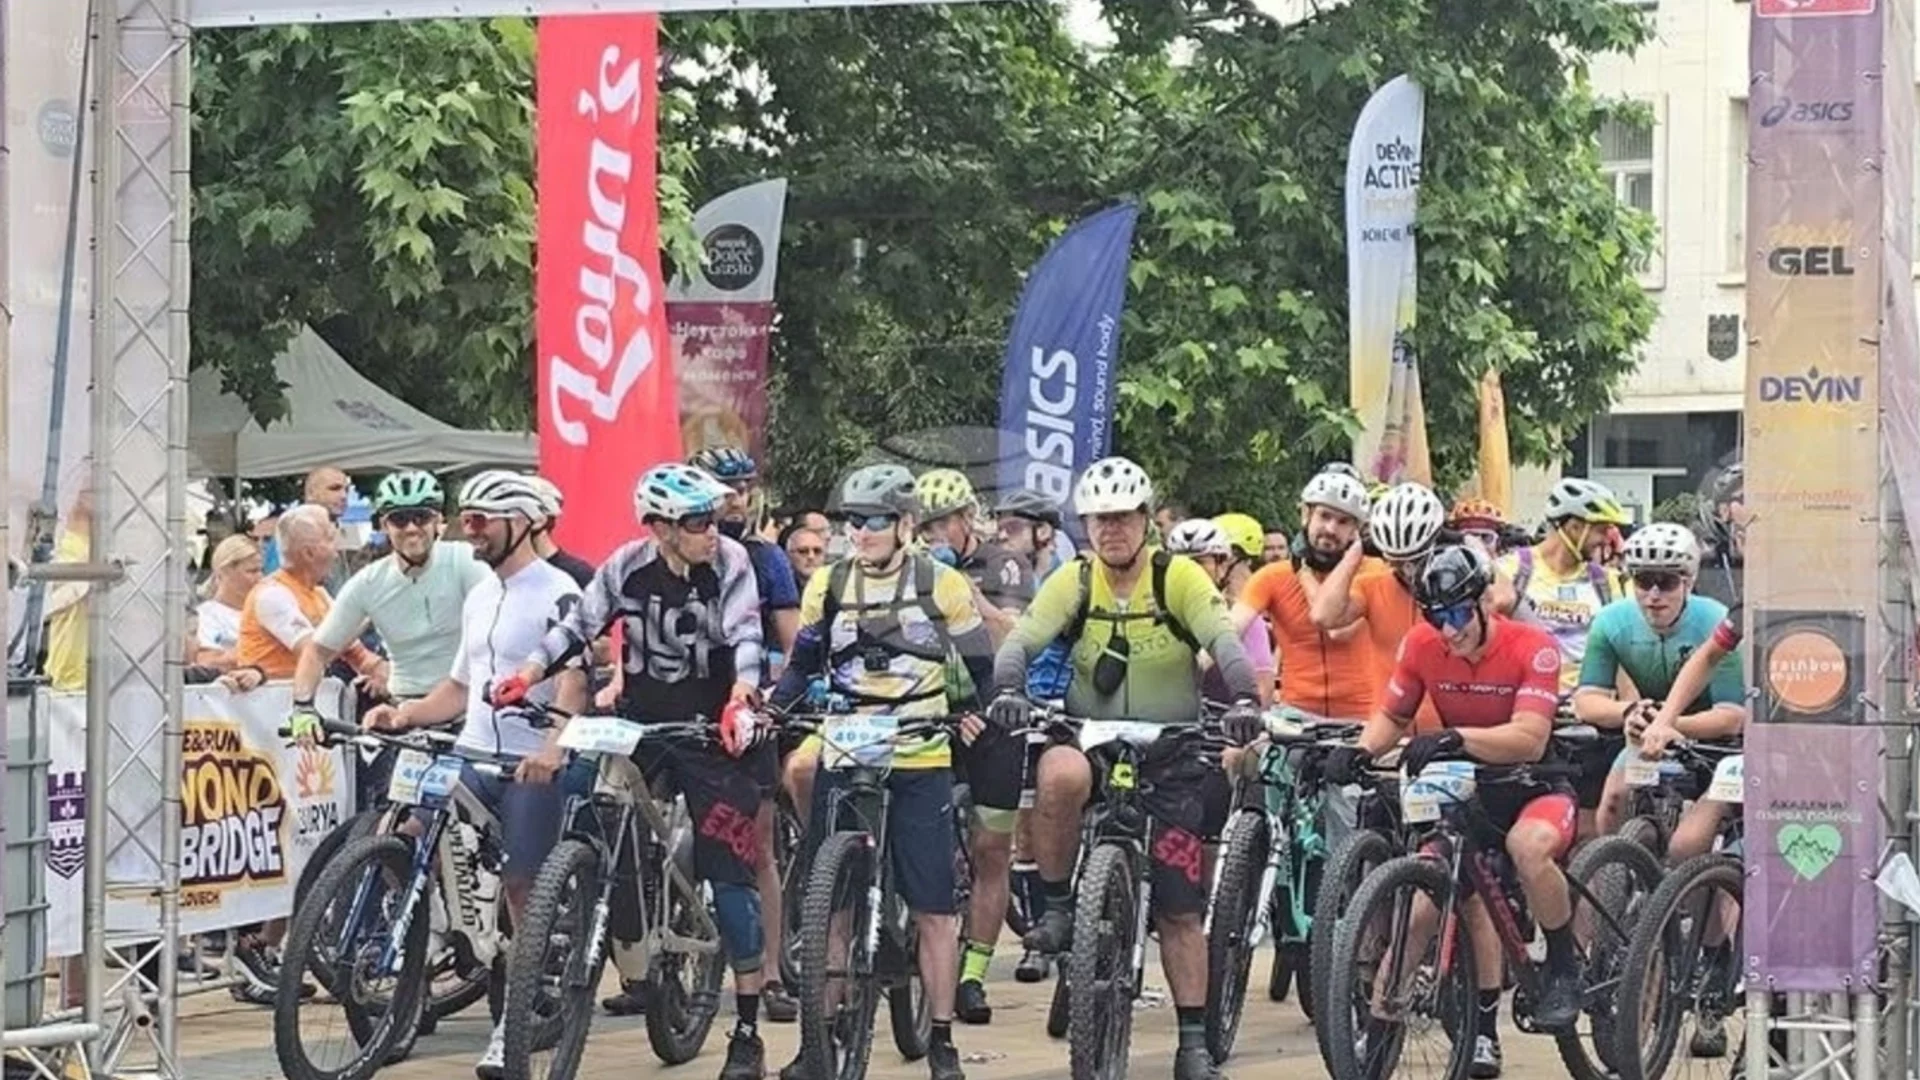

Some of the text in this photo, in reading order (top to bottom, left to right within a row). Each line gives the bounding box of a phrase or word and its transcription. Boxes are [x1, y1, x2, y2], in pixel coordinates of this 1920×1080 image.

[1768, 246, 1854, 276] GEL
[1095, 314, 1115, 358] body
[1093, 359, 1108, 412] sound
[1760, 372, 1862, 403] DEVIN
[1770, 657, 1844, 673] rainbow
[180, 806, 282, 878] BRIDGE
